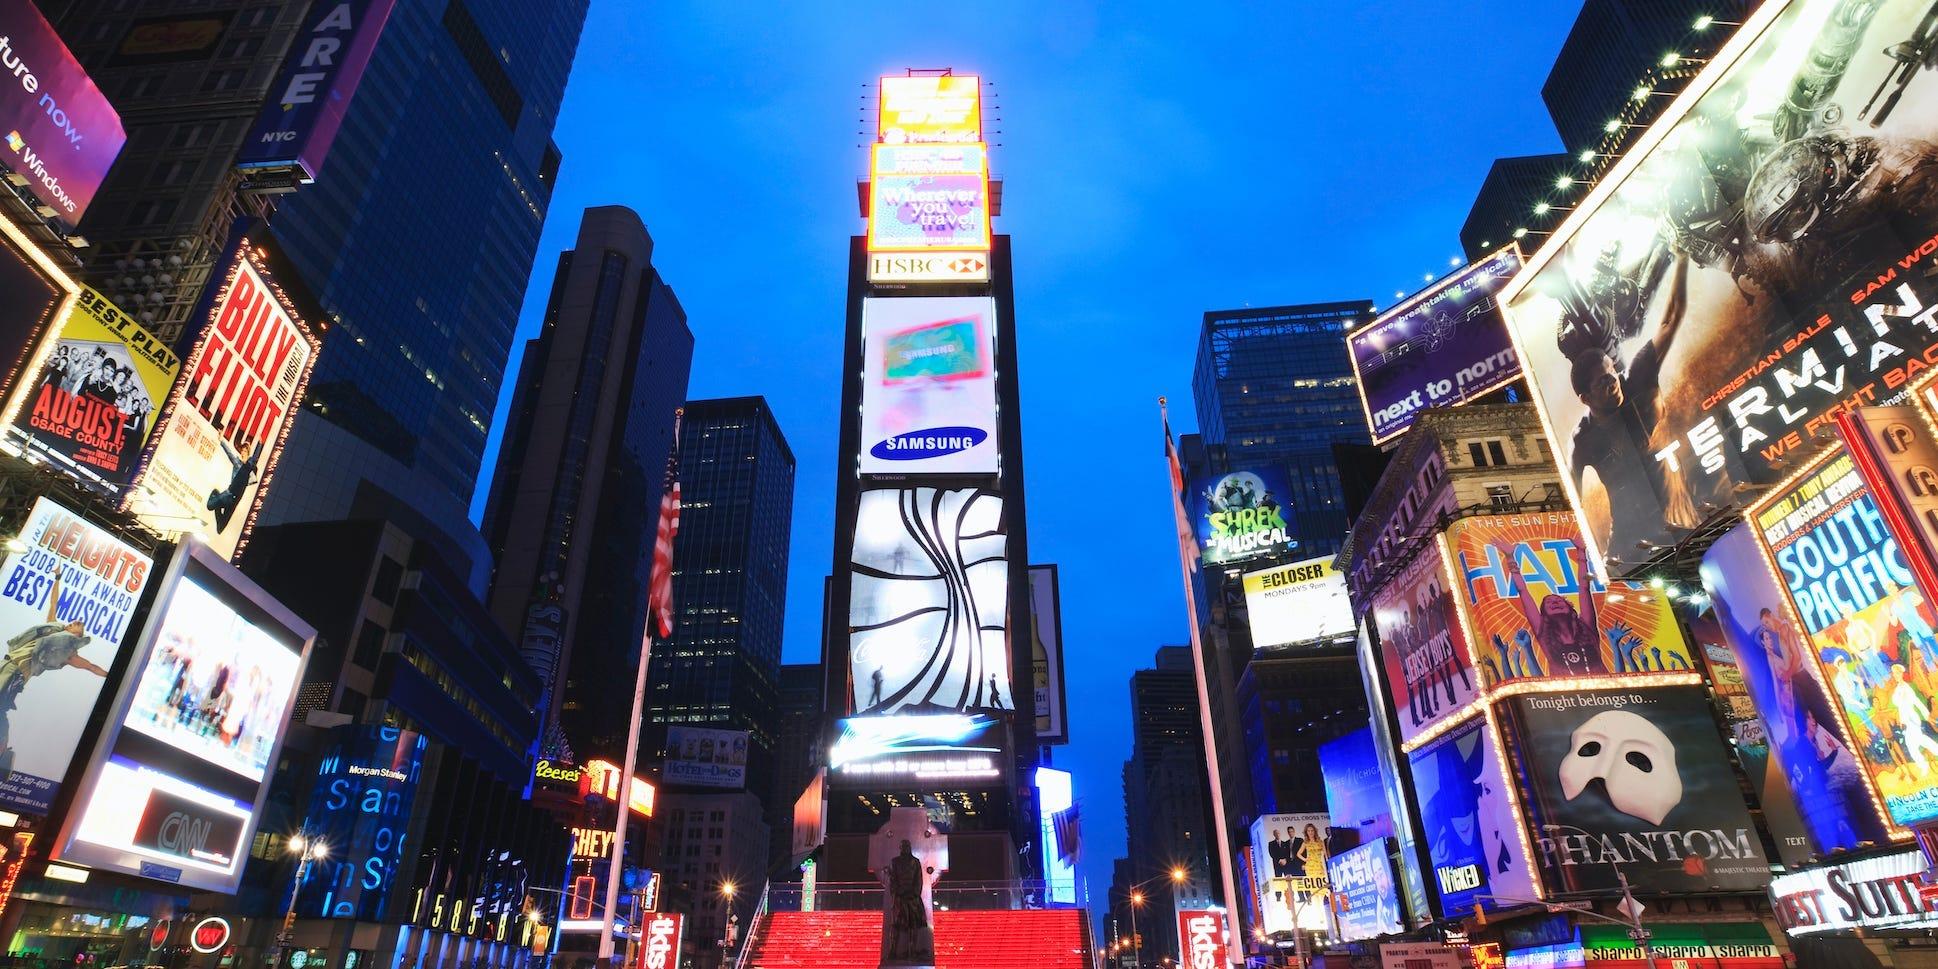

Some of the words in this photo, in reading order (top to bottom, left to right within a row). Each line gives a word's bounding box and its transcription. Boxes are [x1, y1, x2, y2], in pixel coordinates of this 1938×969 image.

[38, 92, 83, 150] now.
[261, 131, 297, 143] NYC
[23, 147, 77, 213] Windows
[911, 203, 948, 217] you
[920, 213, 976, 226] travel
[874, 258, 943, 274] HSBC
[1851, 267, 1897, 305] SAM
[1398, 283, 1462, 323] breathtaking
[80, 288, 131, 332] BEST
[131, 330, 178, 369] PLAY
[92, 314, 109, 327] TONY
[107, 326, 129, 343] AWARD
[216, 269, 297, 391] BILLY
[1701, 350, 1782, 412] CHRISTIAN
[1782, 313, 1832, 354] BALE
[184, 332, 283, 450] ELLIOT
[275, 383, 289, 406] THE
[1373, 389, 1424, 427] next
[1426, 378, 1452, 400] to
[30, 416, 74, 439] OSAGE
[76, 431, 124, 455] COUNTY
[1760, 430, 1802, 462] WE
[1804, 383, 1876, 438] FIGHT
[886, 436, 974, 451] SAMSUNG
[1208, 505, 1288, 538] SHREK
[1475, 518, 1505, 530] THE
[1510, 516, 1543, 527] SUN
[1772, 528, 1806, 553] RODGERS
[1810, 487, 1868, 528] HAMMERSTEIN
[38, 510, 147, 594] HEIGHTS
[1216, 527, 1291, 554] MUSICAL
[1775, 493, 1890, 593] SOUTH
[20, 545, 56, 575] 2008
[60, 563, 91, 591] TONY
[91, 581, 133, 612] AWARD
[1261, 574, 1272, 589] THE
[1271, 563, 1324, 587] CLOSER
[1264, 584, 1308, 599] MONDAYS
[1793, 537, 1914, 635] PACIFIC
[2, 564, 55, 611] BEST
[56, 587, 126, 644] MUSICAL
[1405, 642, 1434, 684] JERSEY
[1428, 628, 1453, 667] BOYS
[1526, 694, 1576, 711] Tonight
[1577, 692, 1628, 709] belongs
[349, 765, 381, 777] Morgan
[380, 767, 408, 782] Stanley
[535, 759, 581, 783] Reese's
[1887, 790, 1929, 808] LINCOLN
[157, 811, 212, 856] CNN
[1536, 828, 1758, 868] PHANTOM
[1785, 837, 1806, 846] TEXT
[412, 887, 479, 936] 1585
[647, 917, 675, 969] tkts
[1190, 914, 1218, 969] tkts
[1592, 945, 1642, 960] sbarro
[1656, 944, 1706, 958] sbarro
[1719, 944, 1771, 958] sbarro
